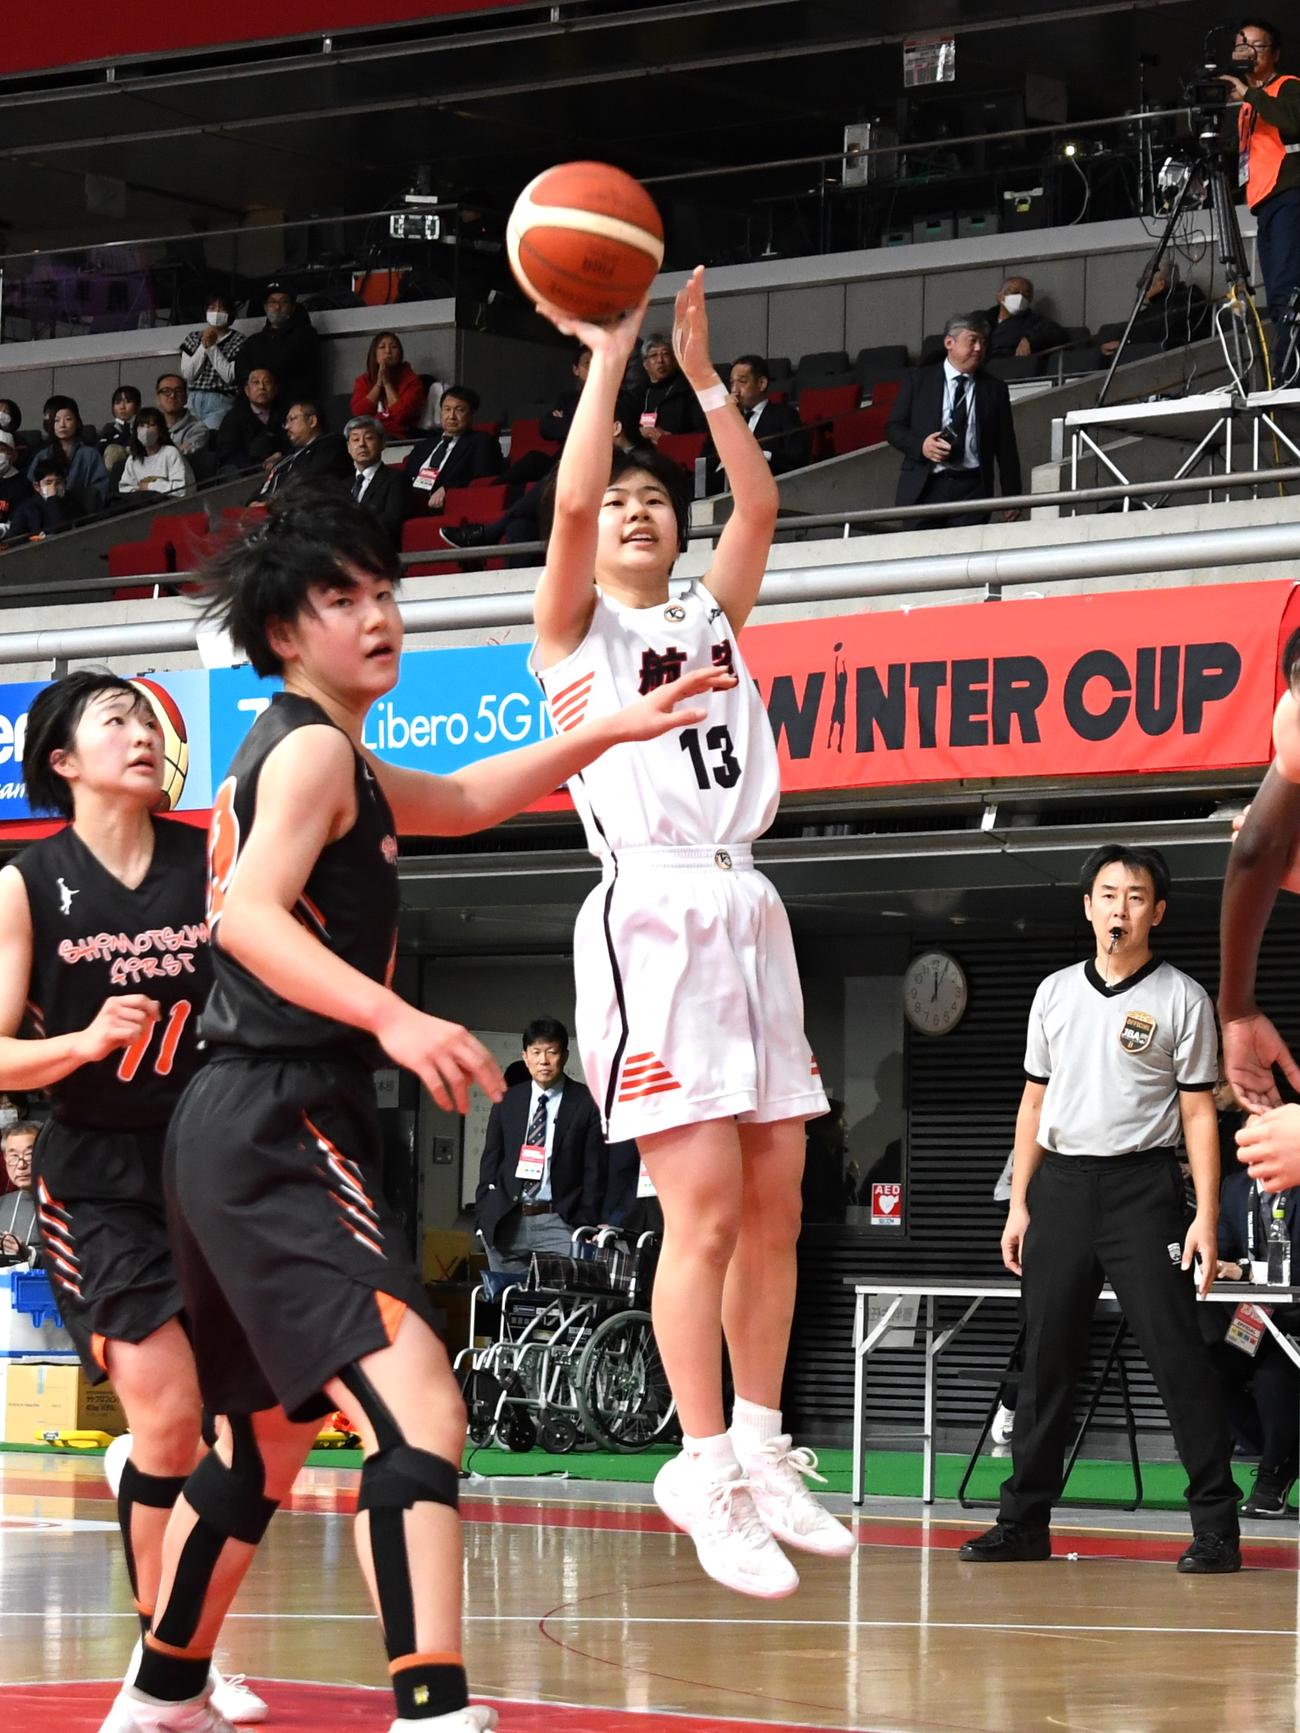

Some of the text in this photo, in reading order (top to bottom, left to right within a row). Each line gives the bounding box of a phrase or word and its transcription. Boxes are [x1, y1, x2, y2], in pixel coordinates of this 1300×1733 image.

[361, 702, 469, 750] Libero
[473, 692, 532, 744] 5G
[753, 641, 1242, 760] WINTER CUP
[679, 724, 742, 790] 13
[875, 1184, 900, 1195] AED
